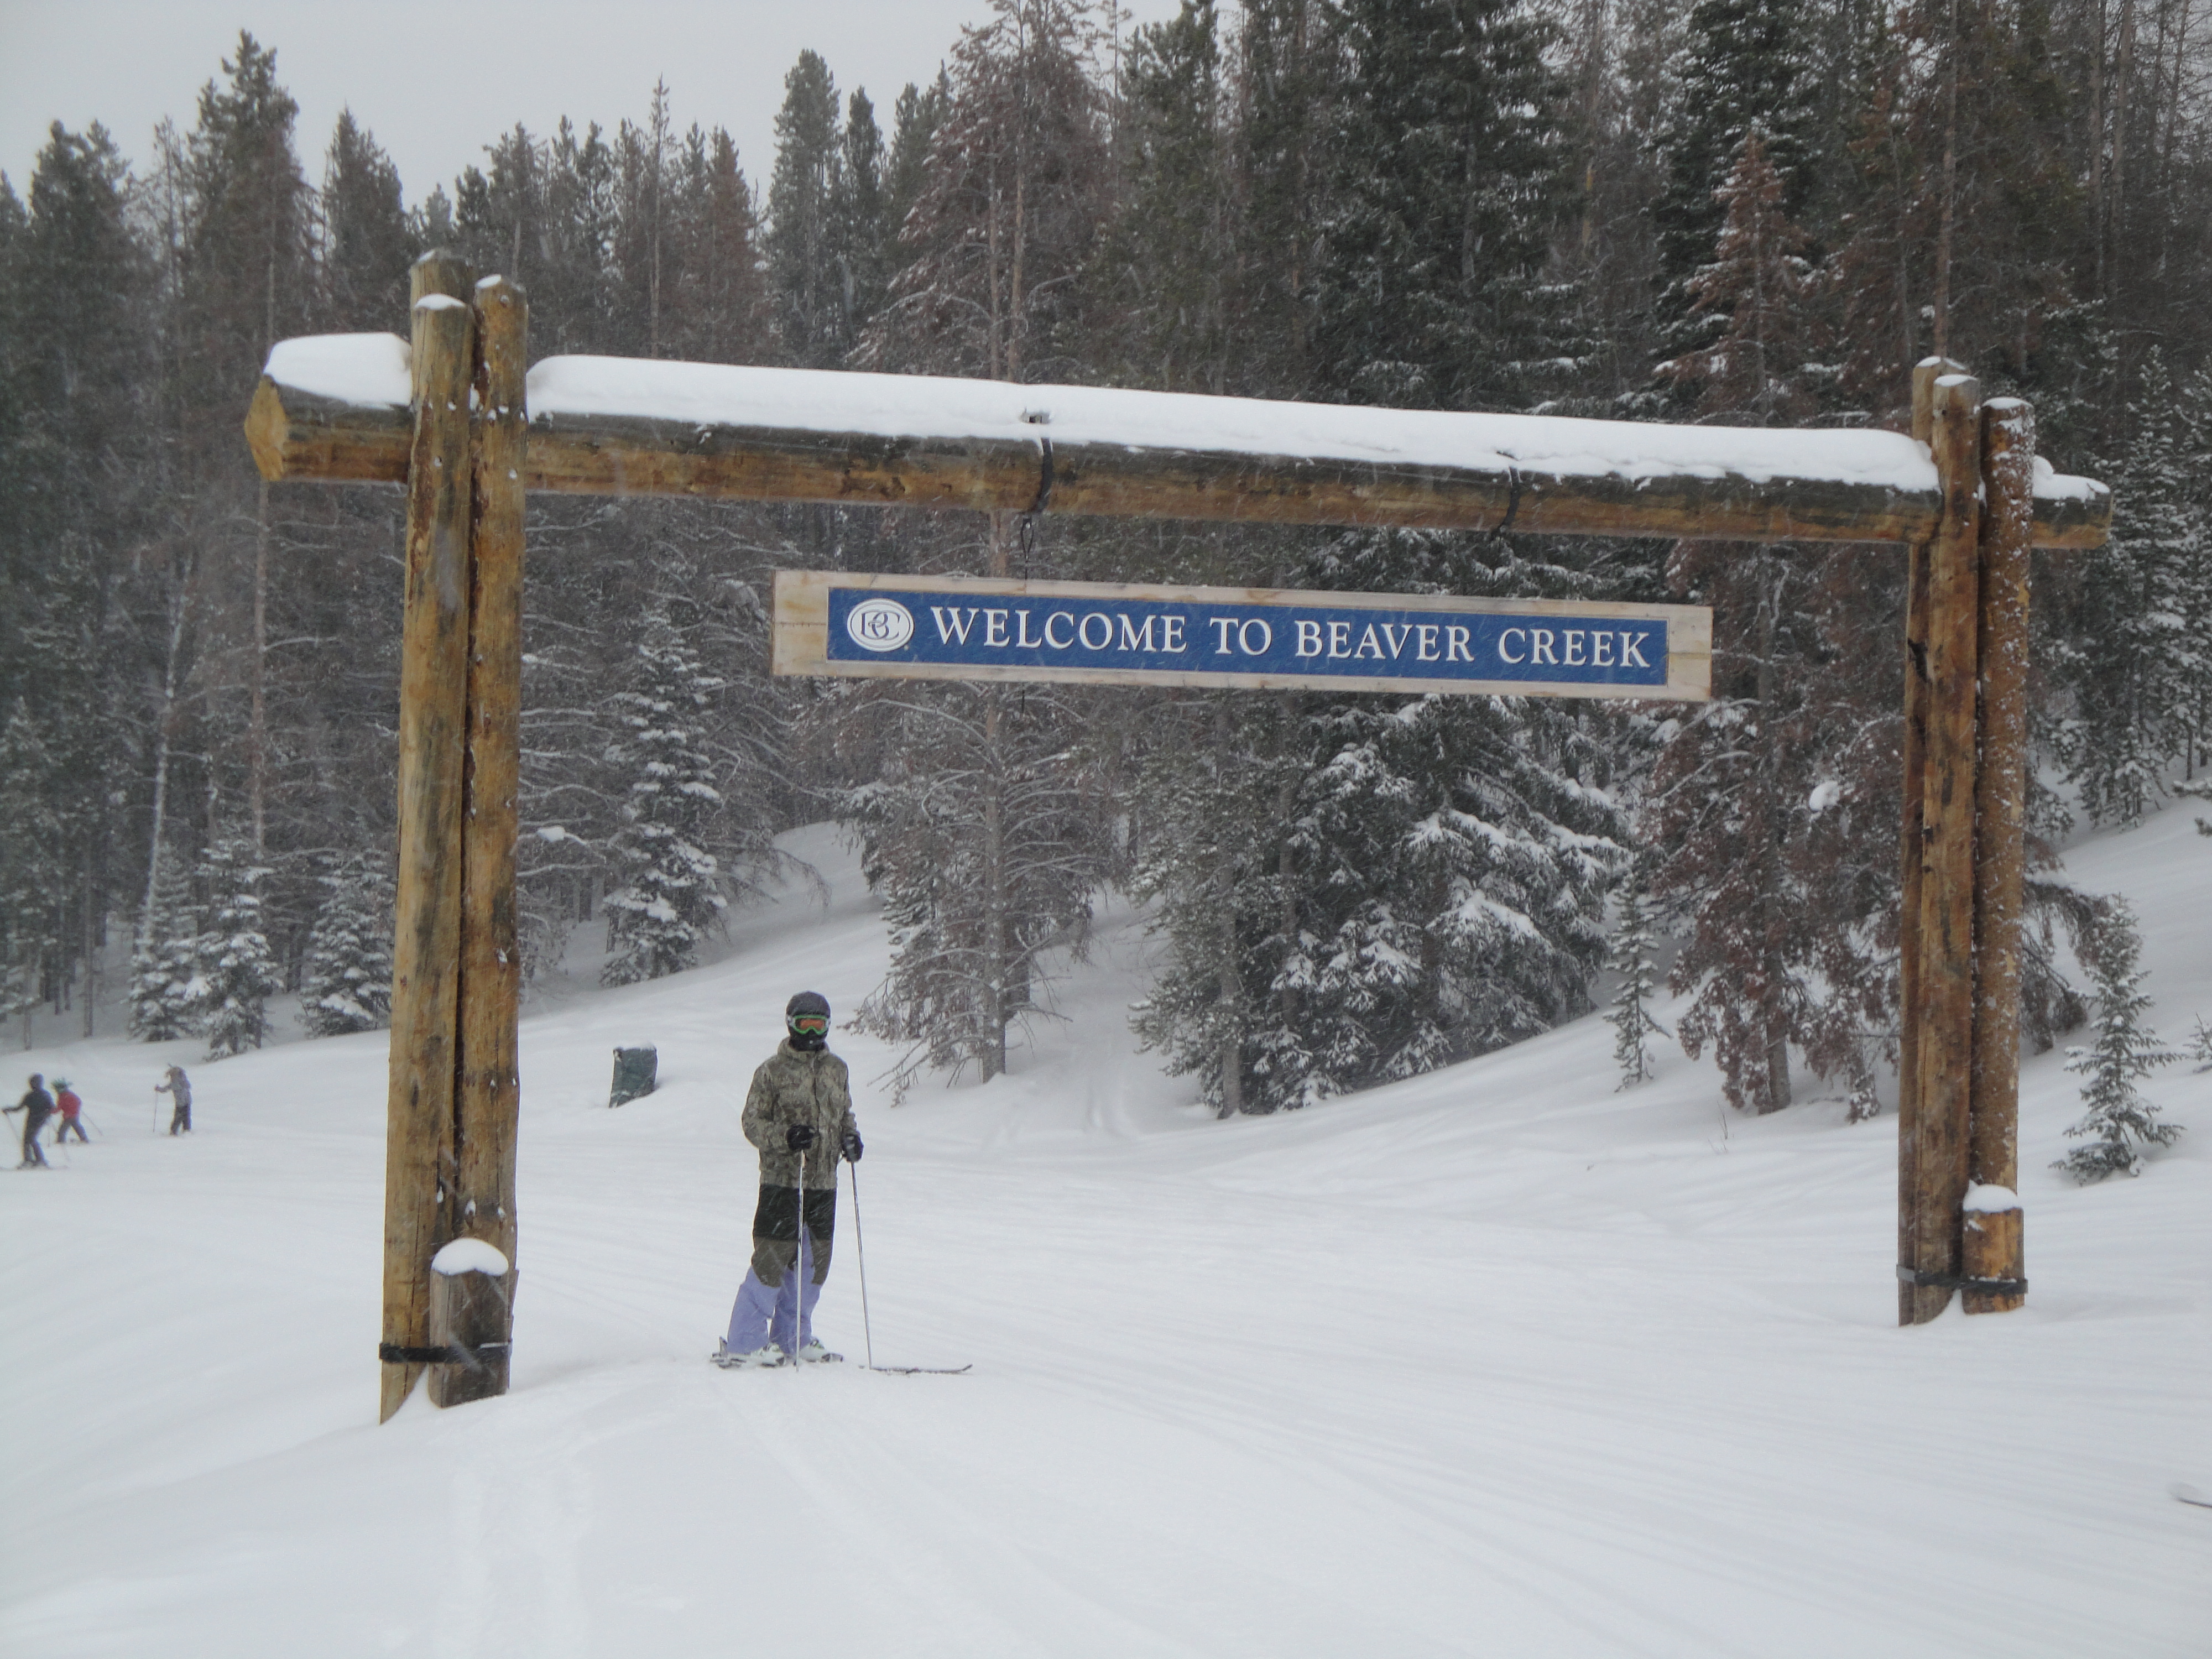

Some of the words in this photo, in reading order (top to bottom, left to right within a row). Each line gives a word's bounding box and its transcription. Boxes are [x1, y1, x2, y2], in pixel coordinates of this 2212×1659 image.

[930, 606, 1187, 654] WELCOME
[1209, 617, 1272, 656] TO
[1295, 620, 1475, 662] BEAVER
[1498, 628, 1651, 668] CREEK
